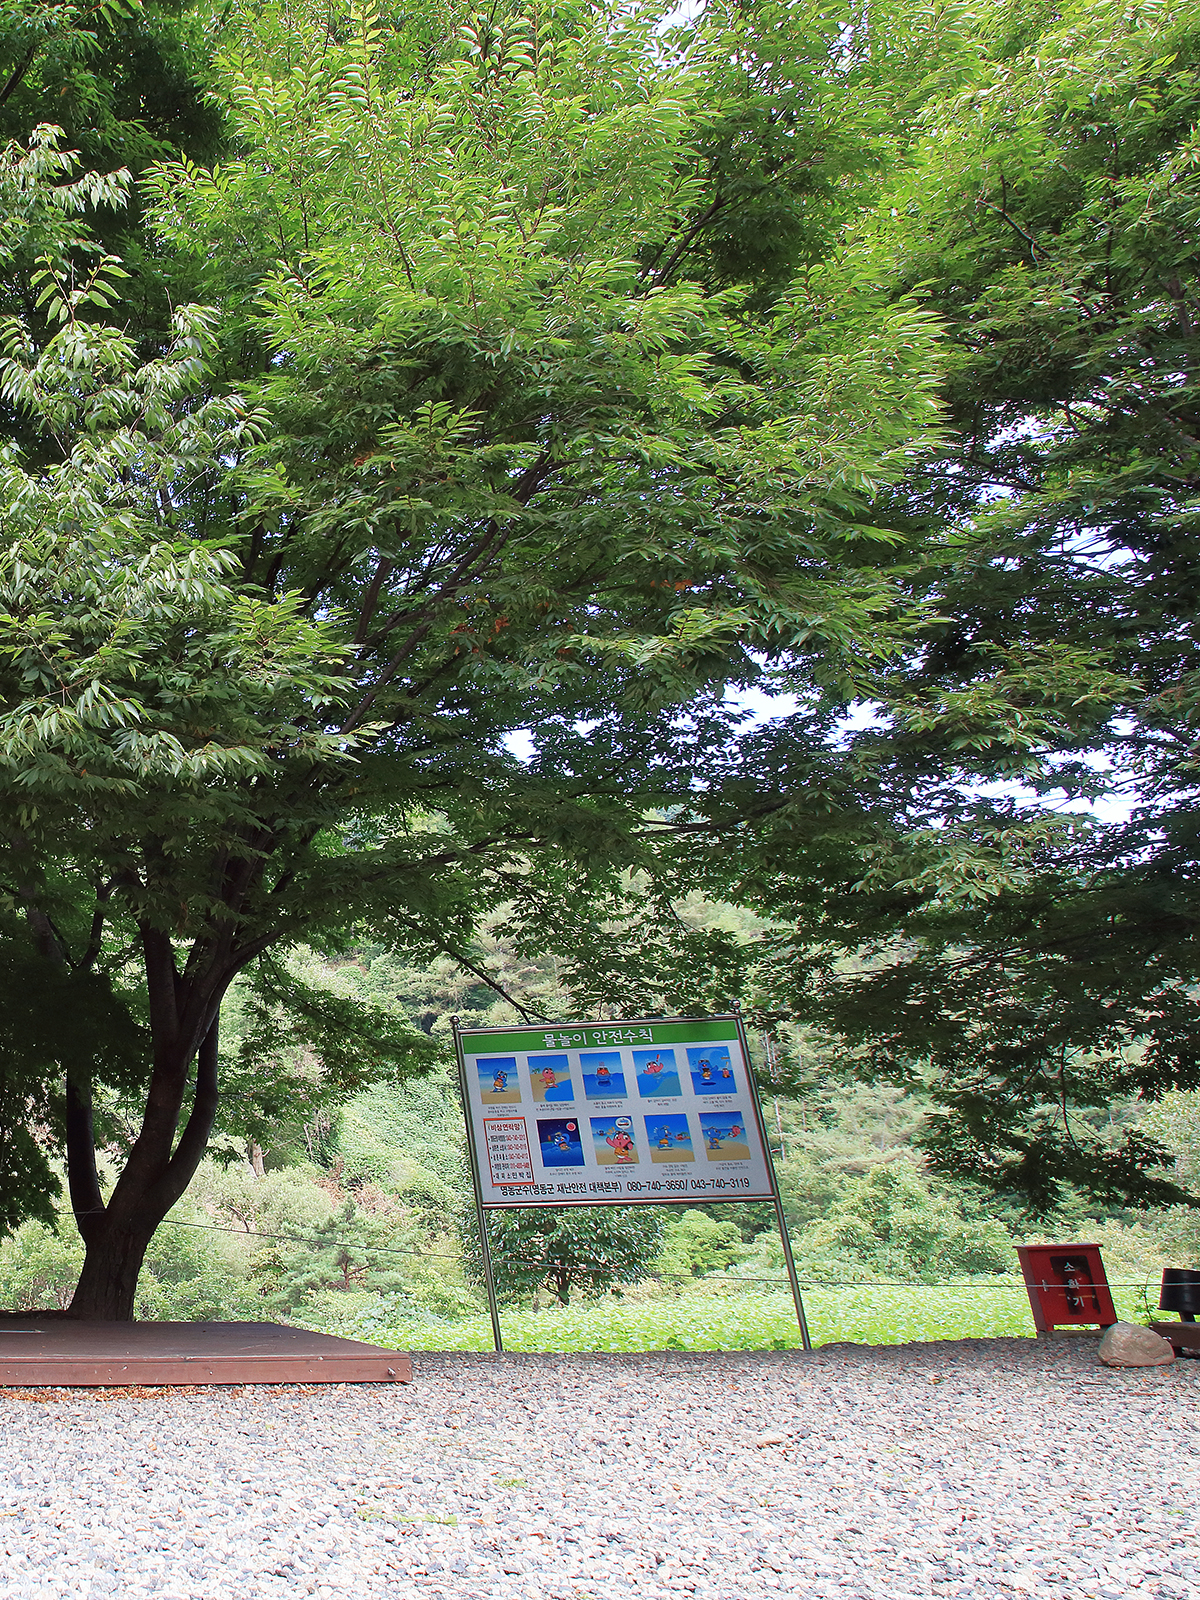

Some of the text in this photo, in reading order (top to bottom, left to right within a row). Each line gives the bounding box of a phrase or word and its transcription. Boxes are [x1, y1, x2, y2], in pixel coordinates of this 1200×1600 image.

[542, 1028, 654, 1048] 물놀이 안전수칙
[556, 1182, 587, 1194] 재난안전
[589, 1180, 622, 1193] 대책본부)
[690, 1177, 750, 1190] 043-740-3119
